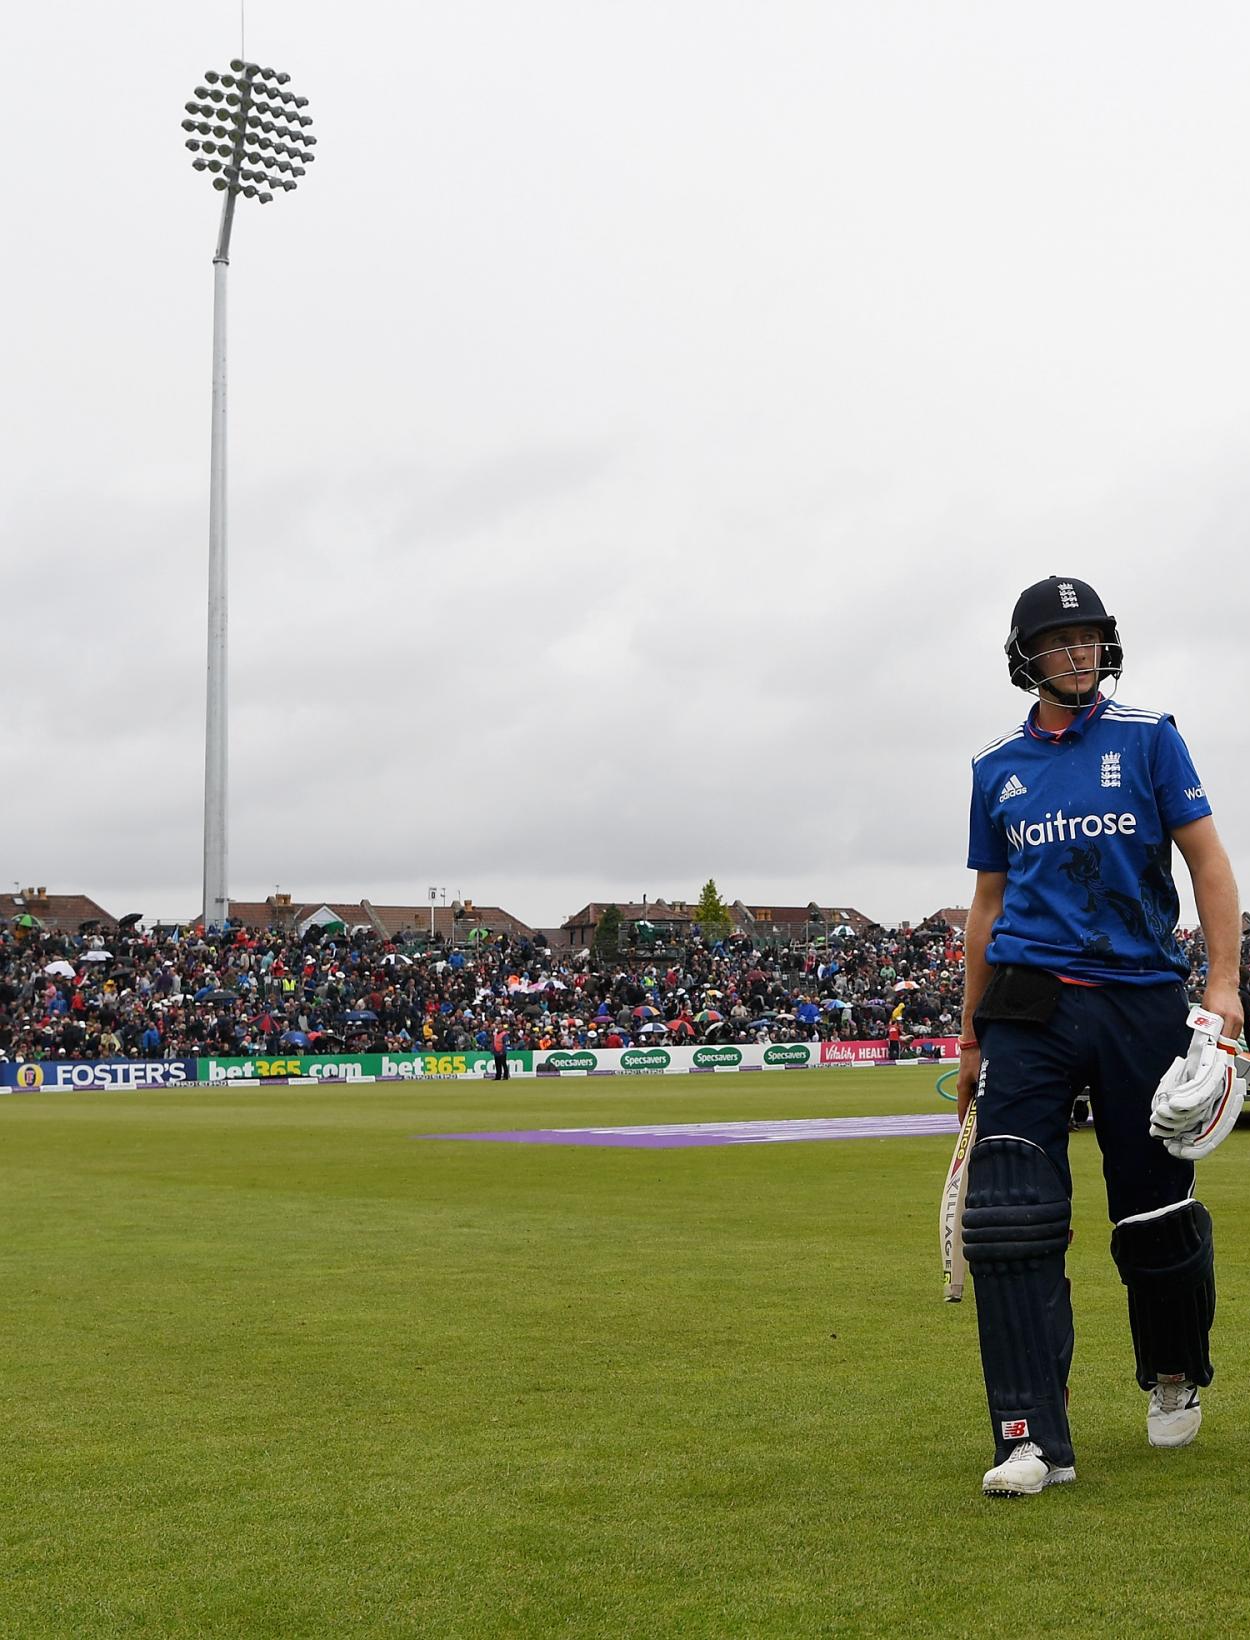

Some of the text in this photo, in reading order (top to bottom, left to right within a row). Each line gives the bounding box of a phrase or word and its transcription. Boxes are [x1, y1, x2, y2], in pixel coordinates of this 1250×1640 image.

[999, 786, 1028, 803] adidas
[1006, 809, 1137, 852] Waitrose
[624, 1055, 667, 1065] Specsavers
[697, 1052, 738, 1063] Specsavers
[767, 1051, 807, 1061] Specsavers
[825, 1044, 856, 1061] Vitality
[209, 1060, 362, 1081] bet365.com
[550, 1057, 593, 1067] Specsavers
[57, 1062, 187, 1086] FOSTER'S
